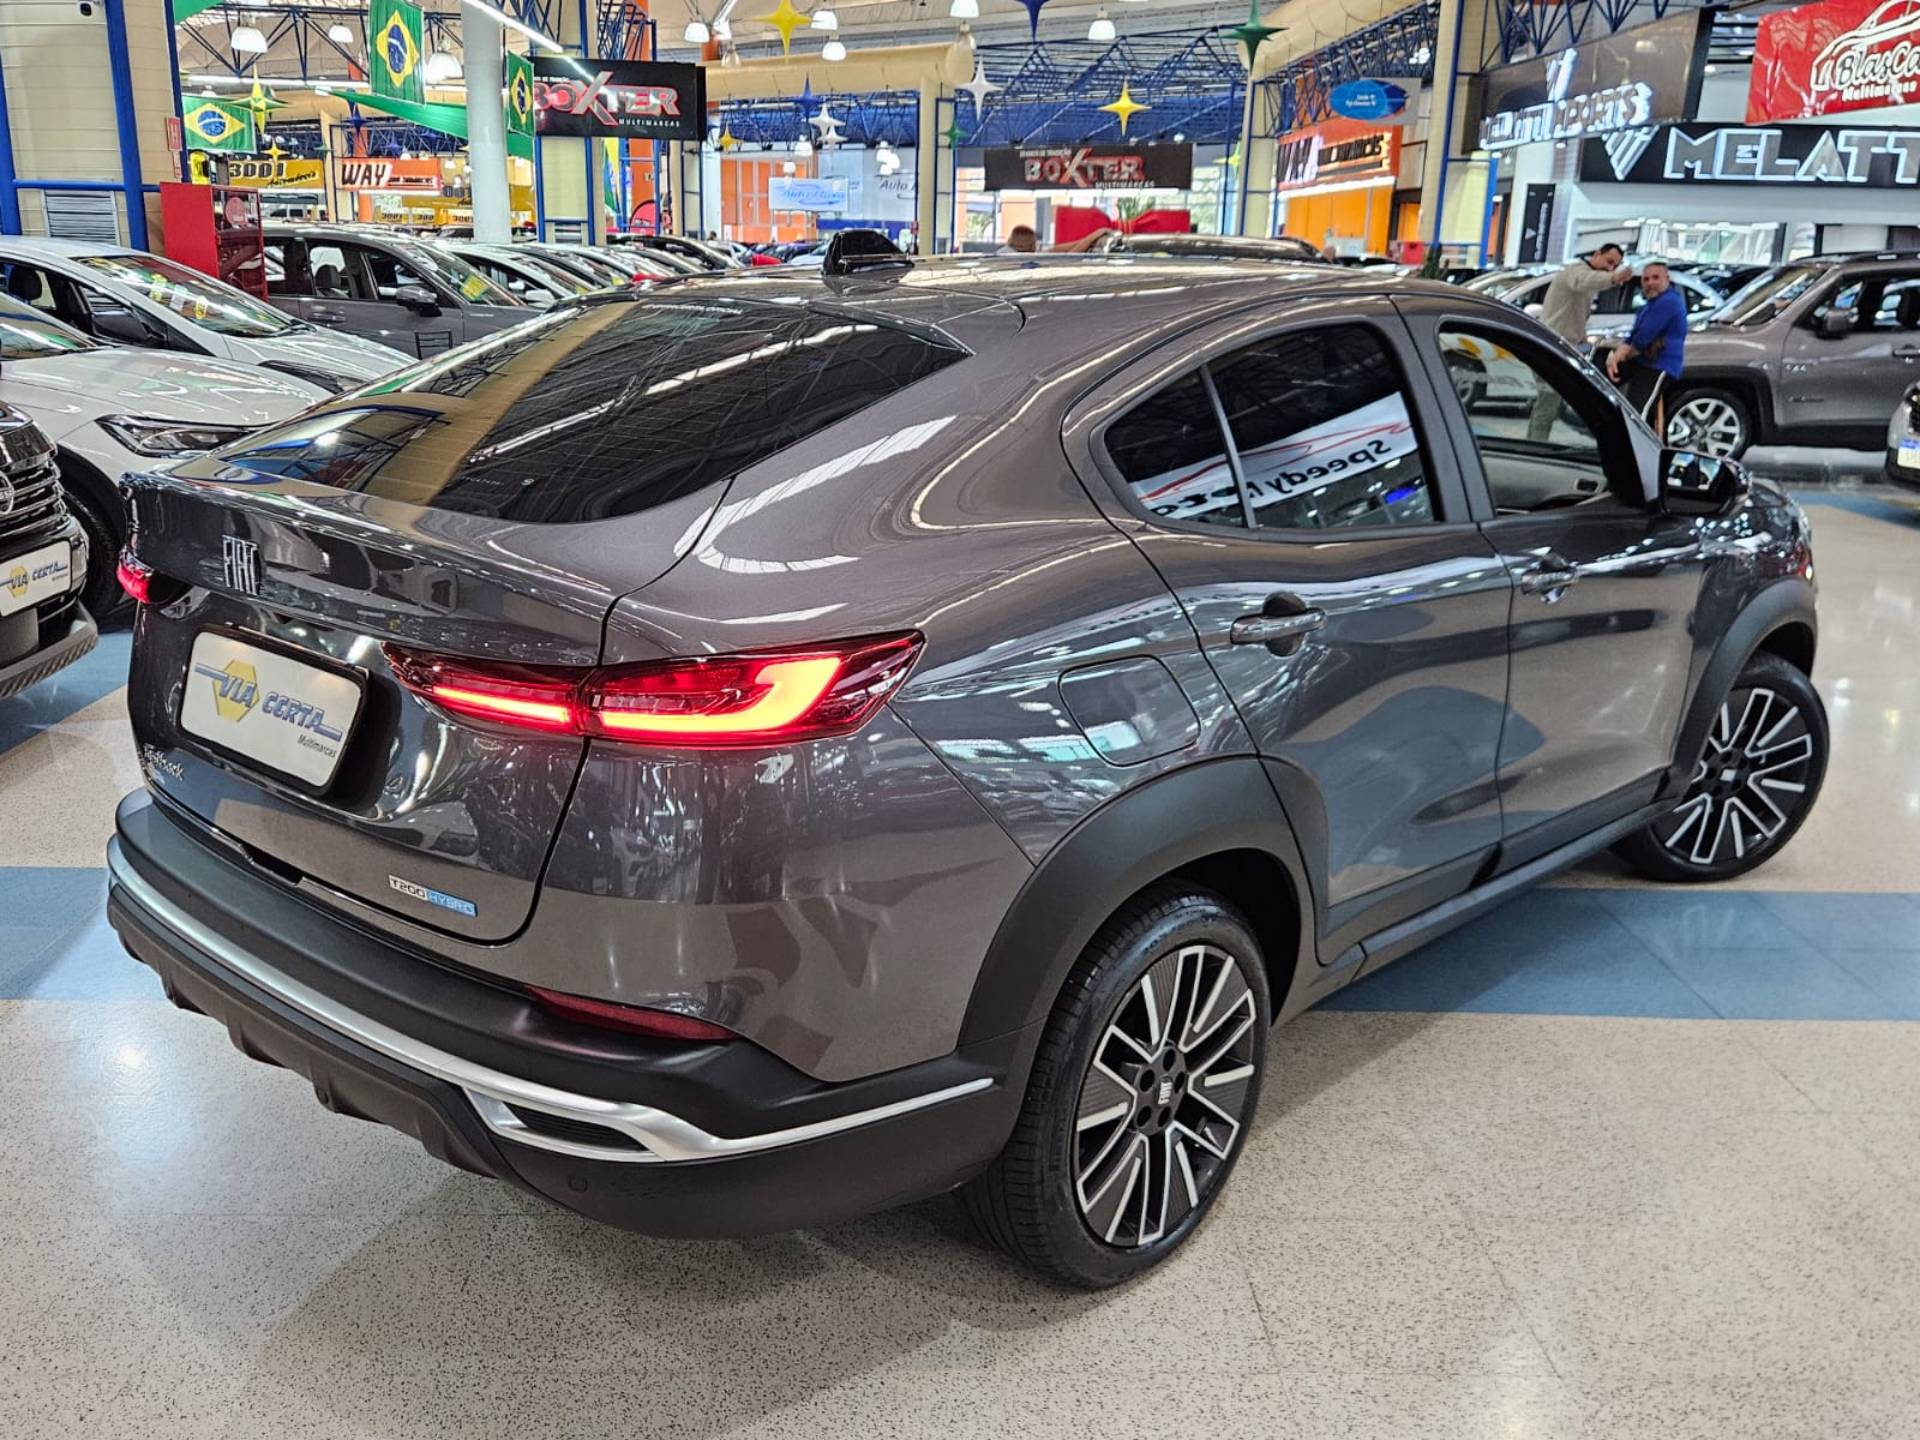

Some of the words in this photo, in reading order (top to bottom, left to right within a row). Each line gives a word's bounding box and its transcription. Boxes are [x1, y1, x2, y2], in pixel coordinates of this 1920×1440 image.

[619, 118, 680, 127] MULTIMARCAS
[341, 163, 387, 186] WAY
[1024, 148, 1144, 188] BOXTER
[222, 534, 261, 596] FIAT
[218, 673, 258, 707] VIA
[261, 691, 326, 732] CERTA
